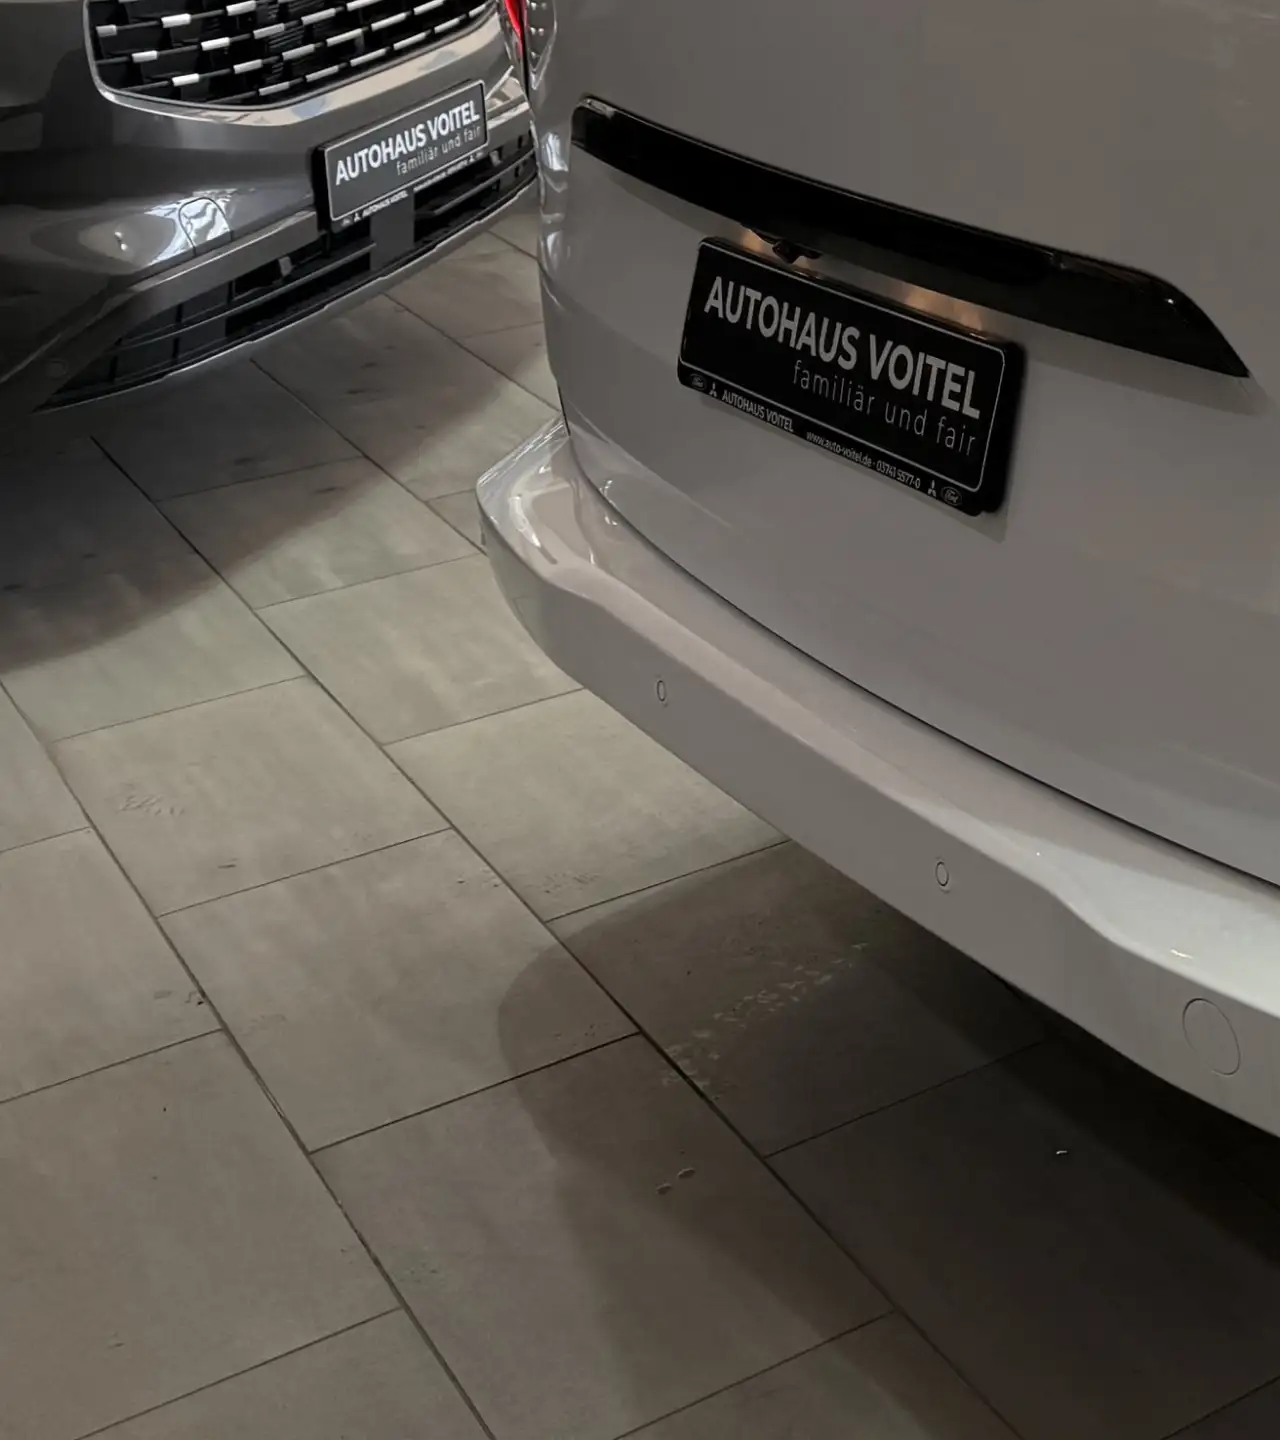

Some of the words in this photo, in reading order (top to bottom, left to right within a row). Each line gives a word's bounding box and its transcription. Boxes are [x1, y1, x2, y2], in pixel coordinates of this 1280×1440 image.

[335, 124, 427, 186] AUTOHAUS
[427, 100, 480, 141] VOITEL
[396, 146, 438, 176] familiär
[442, 133, 461, 154] und
[464, 126, 481, 144] fair
[704, 276, 860, 371] AUTOHAUS
[870, 334, 980, 420] VOITEL
[722, 389, 764, 419] AUTOHAUS
[766, 408, 794, 432] VOITEL
[793, 360, 875, 416] familiär
[885, 401, 928, 437] und
[936, 416, 976, 456] fair
[806, 431, 872, 467] www.auto-voitel.de
